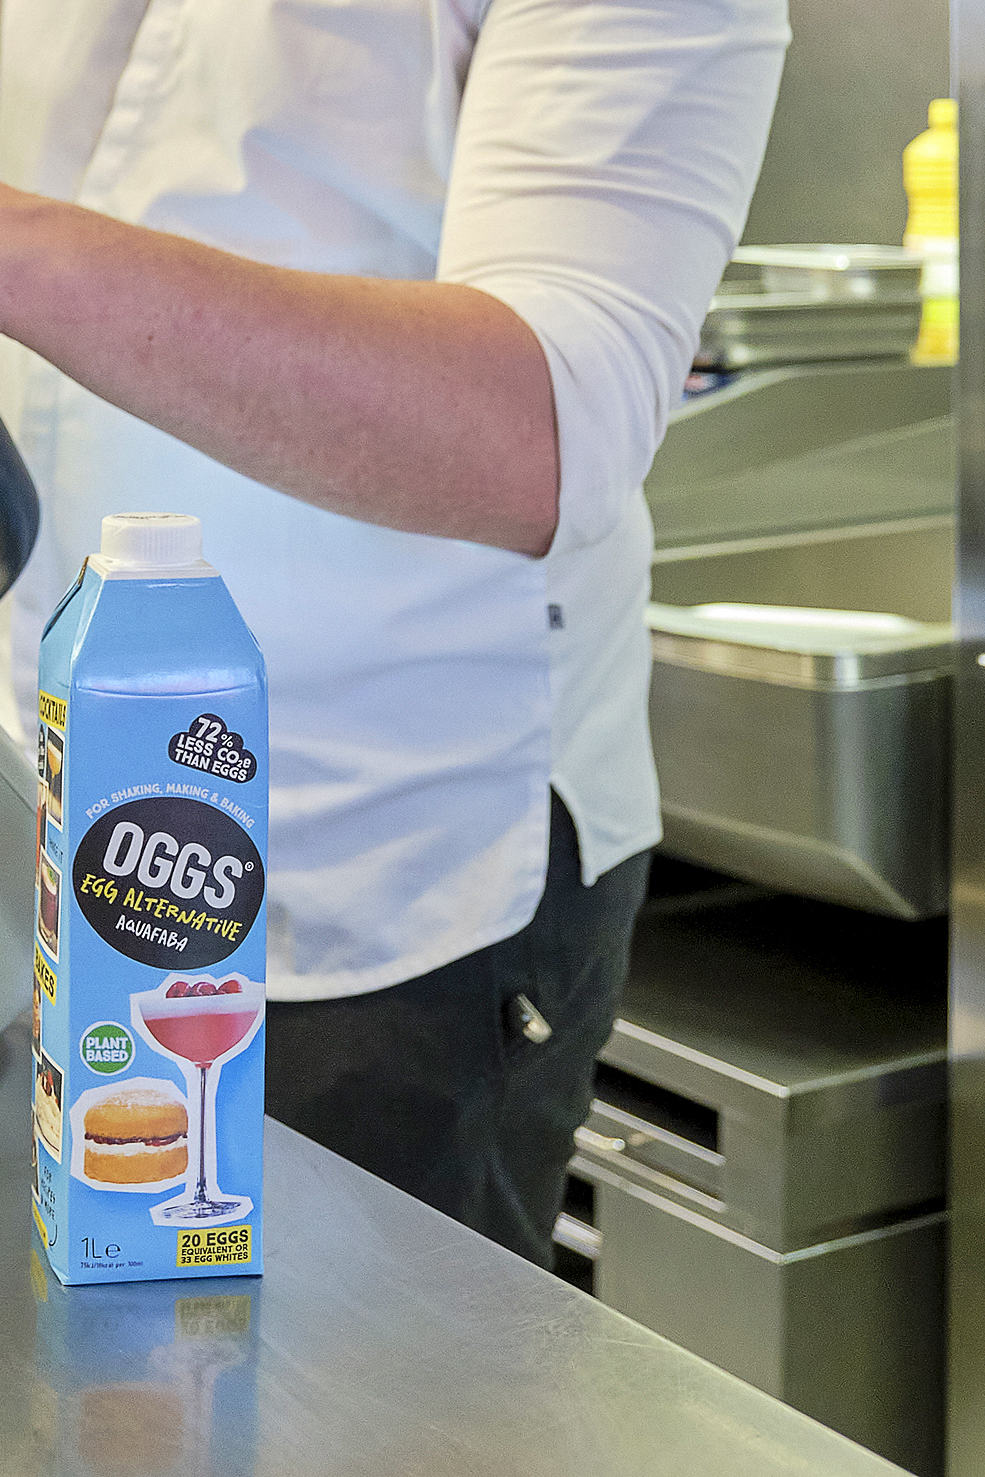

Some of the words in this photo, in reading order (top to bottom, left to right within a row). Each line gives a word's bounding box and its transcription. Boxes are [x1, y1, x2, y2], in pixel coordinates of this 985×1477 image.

[177, 734, 214, 757] LESS
[175, 748, 210, 770] THAN
[211, 760, 247, 781] EGGS
[85, 798, 110, 819] FOR
[166, 783, 210, 799] MAKING
[210, 792, 219, 804] &
[219, 797, 255, 829] BAKING
[80, 873, 118, 904] EGG
[115, 914, 189, 953] AQUAFABA
[86, 1036, 129, 1050] PLANT
[86, 1049, 129, 1062] BASED
[181, 1234, 201, 1248] 20
[206, 1229, 249, 1246] EGGS
[180, 1256, 192, 1264] 33
[194, 1254, 213, 1263] EGG
[215, 1251, 249, 1262] WHITES
[181, 1245, 233, 1256] EQUIVALENT
[235, 1243, 248, 1252] OR
